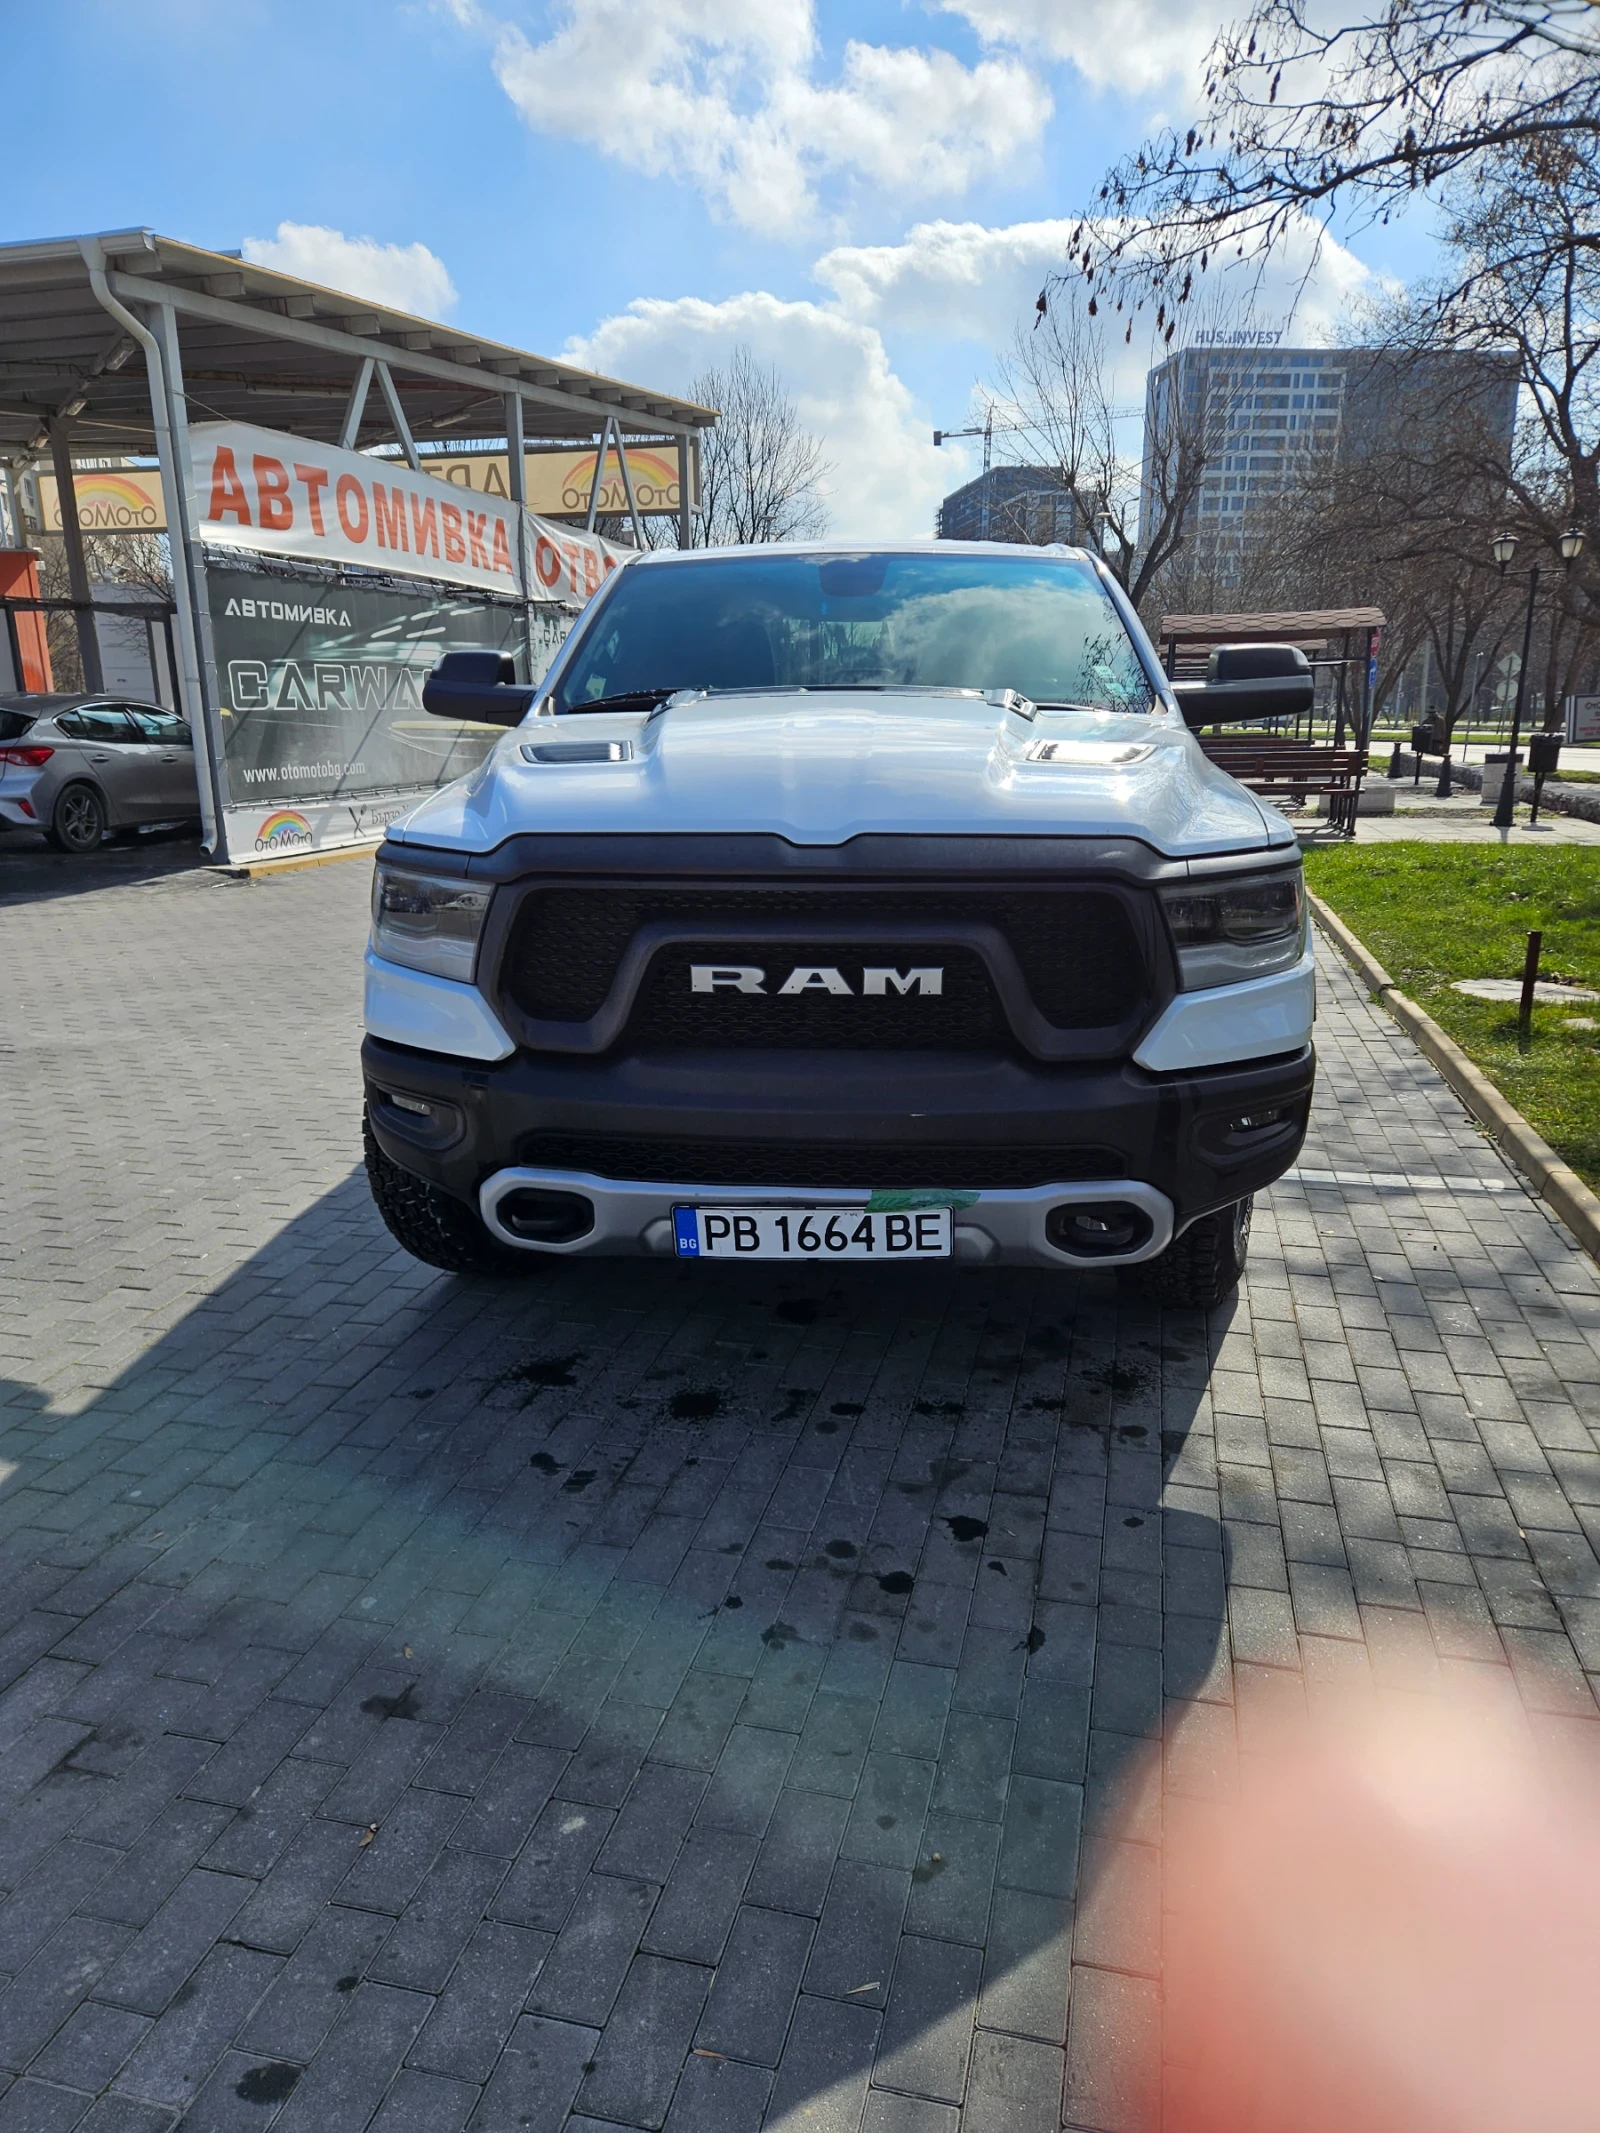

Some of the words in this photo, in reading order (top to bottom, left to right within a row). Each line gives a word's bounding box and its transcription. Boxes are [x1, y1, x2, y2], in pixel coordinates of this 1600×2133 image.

[207, 445, 513, 574] АВТОМИВКА
[224, 597, 352, 627] АВТОМИВКА
[543, 629, 569, 644] CAR
[228, 659, 432, 711] CARWA
[243, 760, 366, 783] www.otomotobg.com
[690, 964, 944, 996] RAM
[679, 1237, 697, 1250] BG
[704, 1214, 761, 1251] PB
[774, 1214, 875, 1252] 1664
[886, 1213, 942, 1252] BE
